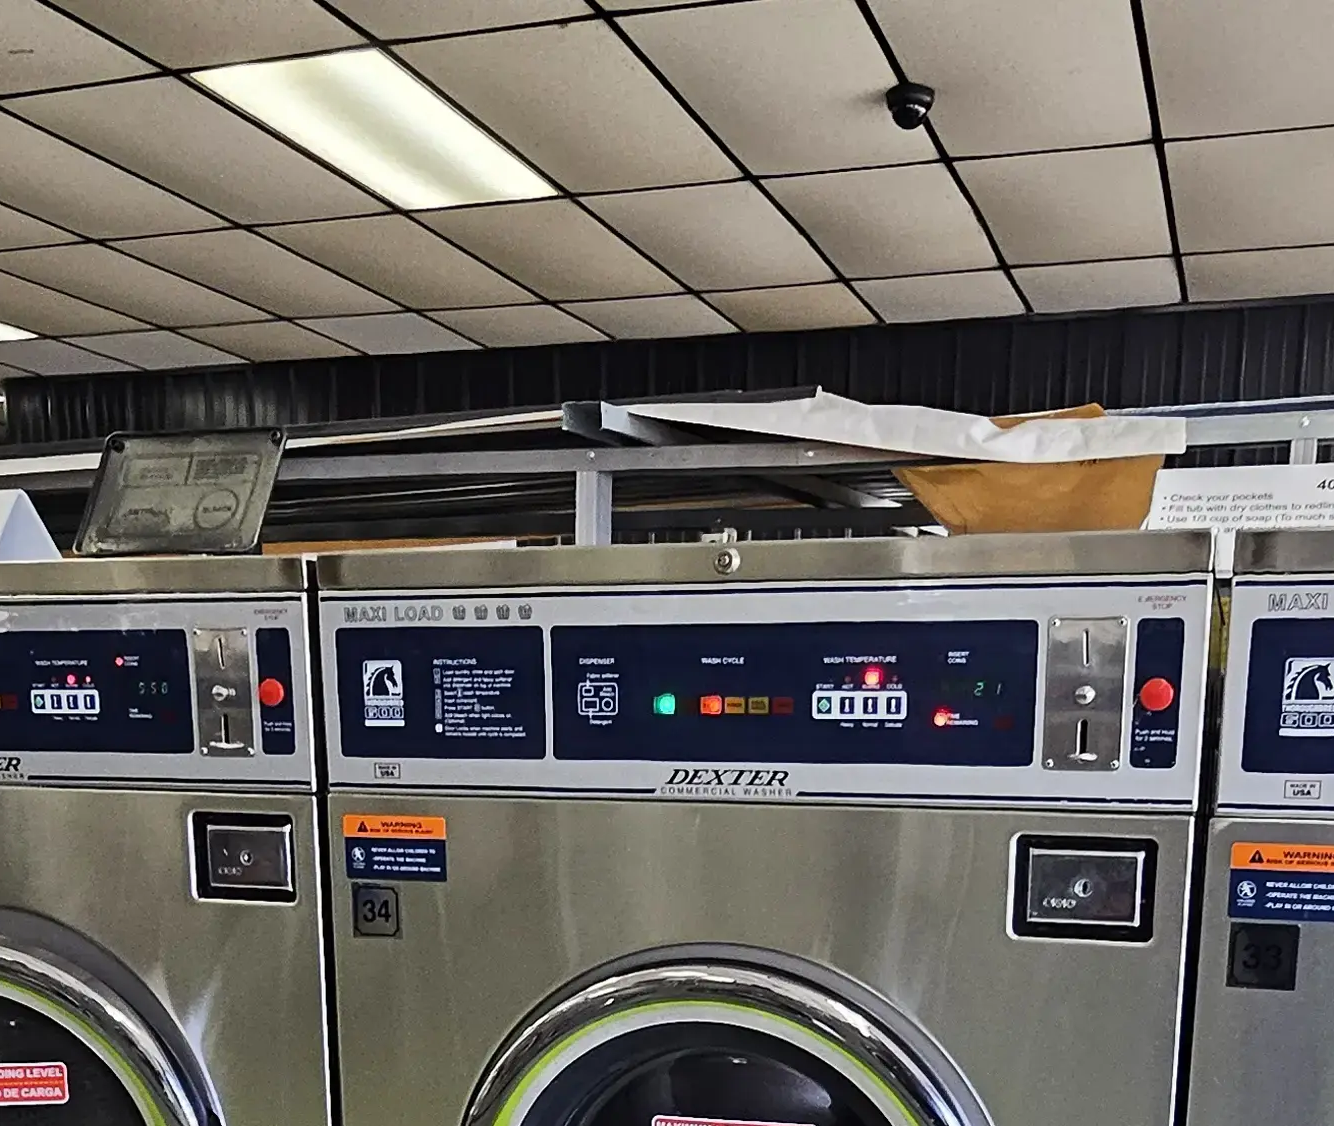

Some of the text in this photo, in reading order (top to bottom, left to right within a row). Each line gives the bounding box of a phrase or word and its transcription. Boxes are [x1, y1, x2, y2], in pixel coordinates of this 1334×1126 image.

[1170, 492, 1274, 504] Check your pockets
[1168, 504, 1184, 513] Fill
[1186, 504, 1203, 513] tub
[1206, 503, 1227, 512] with
[1229, 503, 1247, 514] dry
[1249, 502, 1288, 512] clothes
[1291, 502, 1302, 511] to
[1167, 515, 1187, 523] Use
[1209, 515, 1229, 524] cup
[1232, 514, 1243, 522] of
[1245, 514, 1271, 524] soap
[1295, 512, 1325, 521] much
[1267, 592, 1329, 612] MAXI
[343, 604, 443, 623] MAXI LOAD
[846, 655, 898, 664] TEMPERATURE
[665, 768, 790, 787] DEXTER
[660, 786, 792, 797] COMMERCIAL WASHER
[1292, 789, 1312, 797] USA
[362, 899, 392, 924] 34
[25, 1067, 63, 1078] LEVEL
[3, 1088, 19, 1098] DE
[21, 1086, 63, 1098] CARGA
